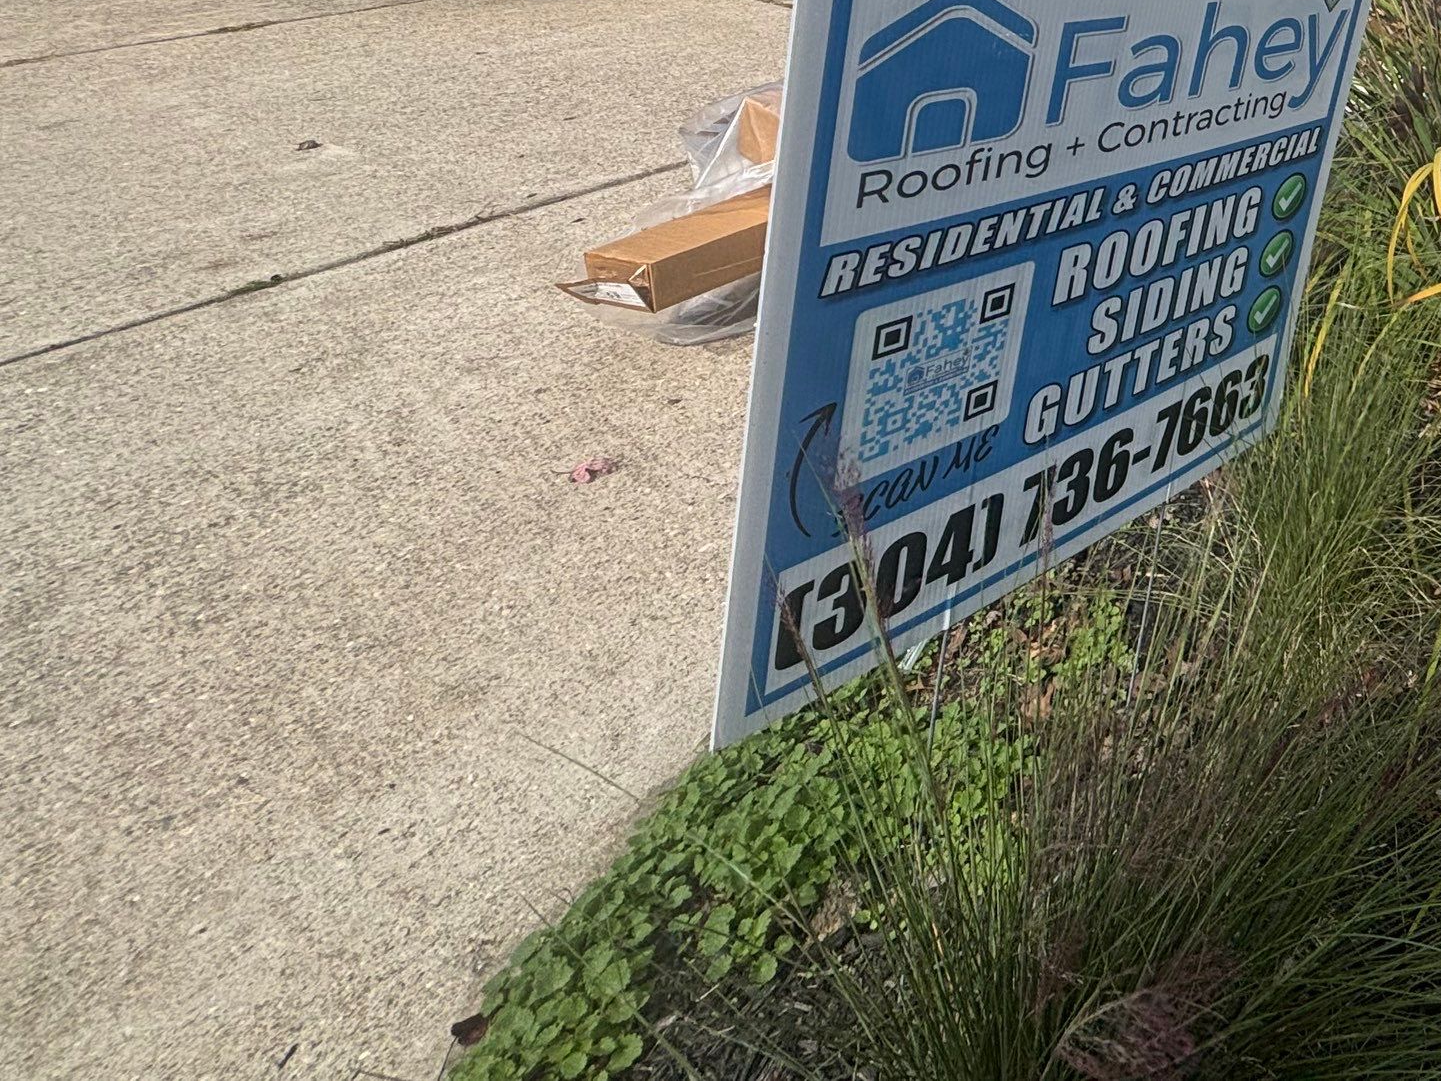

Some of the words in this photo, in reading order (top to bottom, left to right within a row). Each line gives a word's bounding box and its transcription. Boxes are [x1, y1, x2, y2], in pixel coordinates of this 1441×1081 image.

[1045, 0, 1350, 126] Fahey
[856, 142, 1053, 209] Roofing
[1066, 136, 1086, 157] +
[1097, 90, 1287, 153] Contracting
[819, 186, 1106, 298] RESIDENTIAL
[1112, 182, 1138, 215] &
[1146, 126, 1322, 205] COMMERCIAL
[1052, 186, 1262, 306] ROOFING
[1087, 246, 1249, 355] SIDING
[925, 356, 969, 377] Fahey
[1023, 304, 1237, 445] GUTTERS
[943, 424, 1000, 479] ME
[775, 493, 1005, 670] (304)
[1019, 354, 1270, 548] 736-7663
